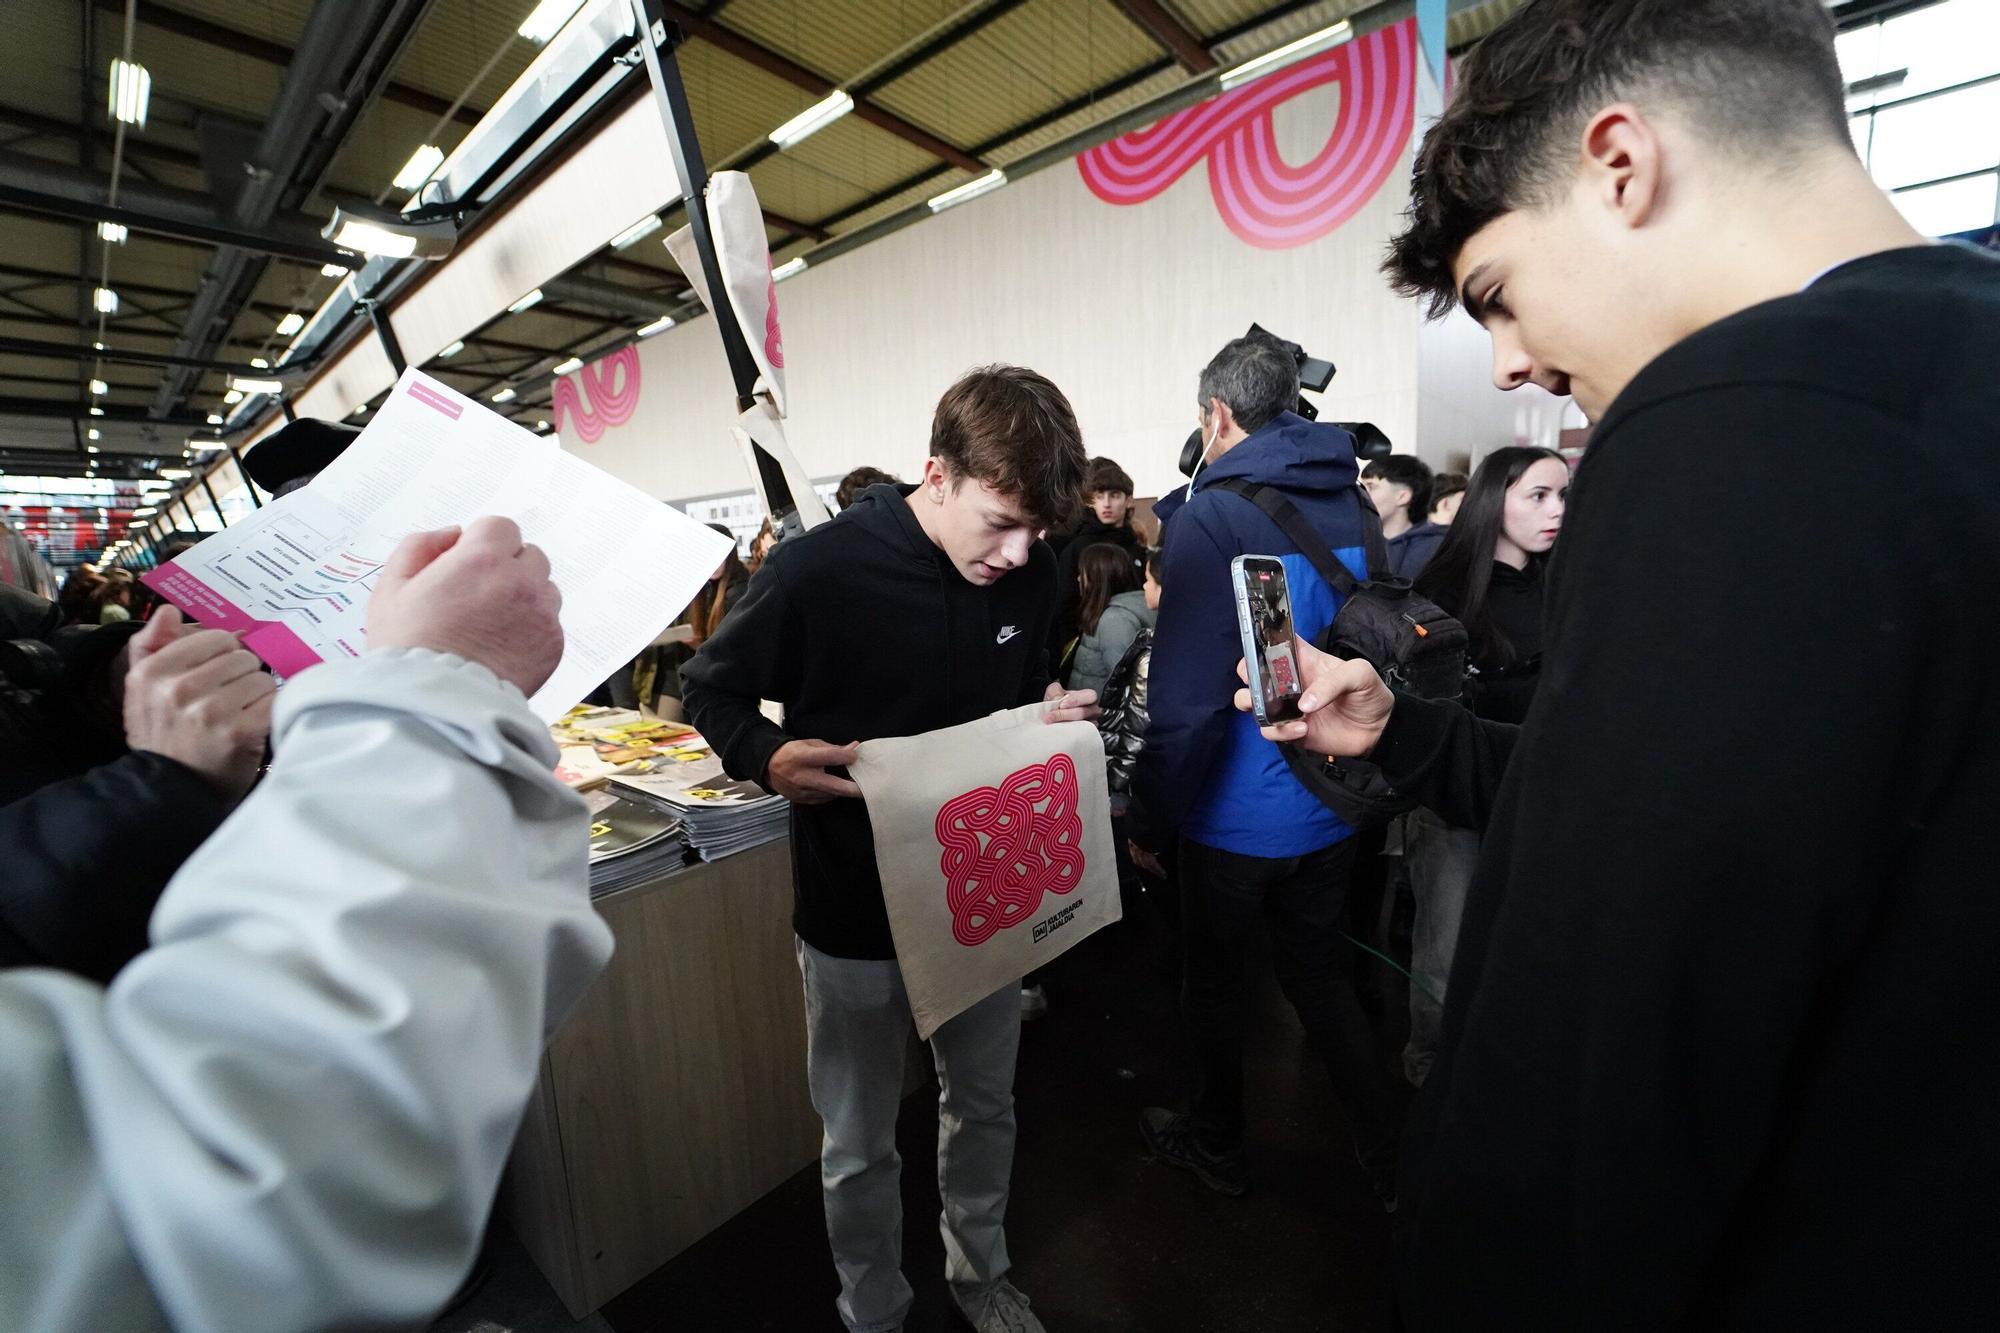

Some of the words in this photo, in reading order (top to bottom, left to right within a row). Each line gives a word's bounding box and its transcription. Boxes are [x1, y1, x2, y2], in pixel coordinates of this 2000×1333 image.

[1000, 625, 1016, 637] NIKE
[1047, 898, 1083, 925] KULTURAREN
[1049, 912, 1075, 933] JAIALDIA
